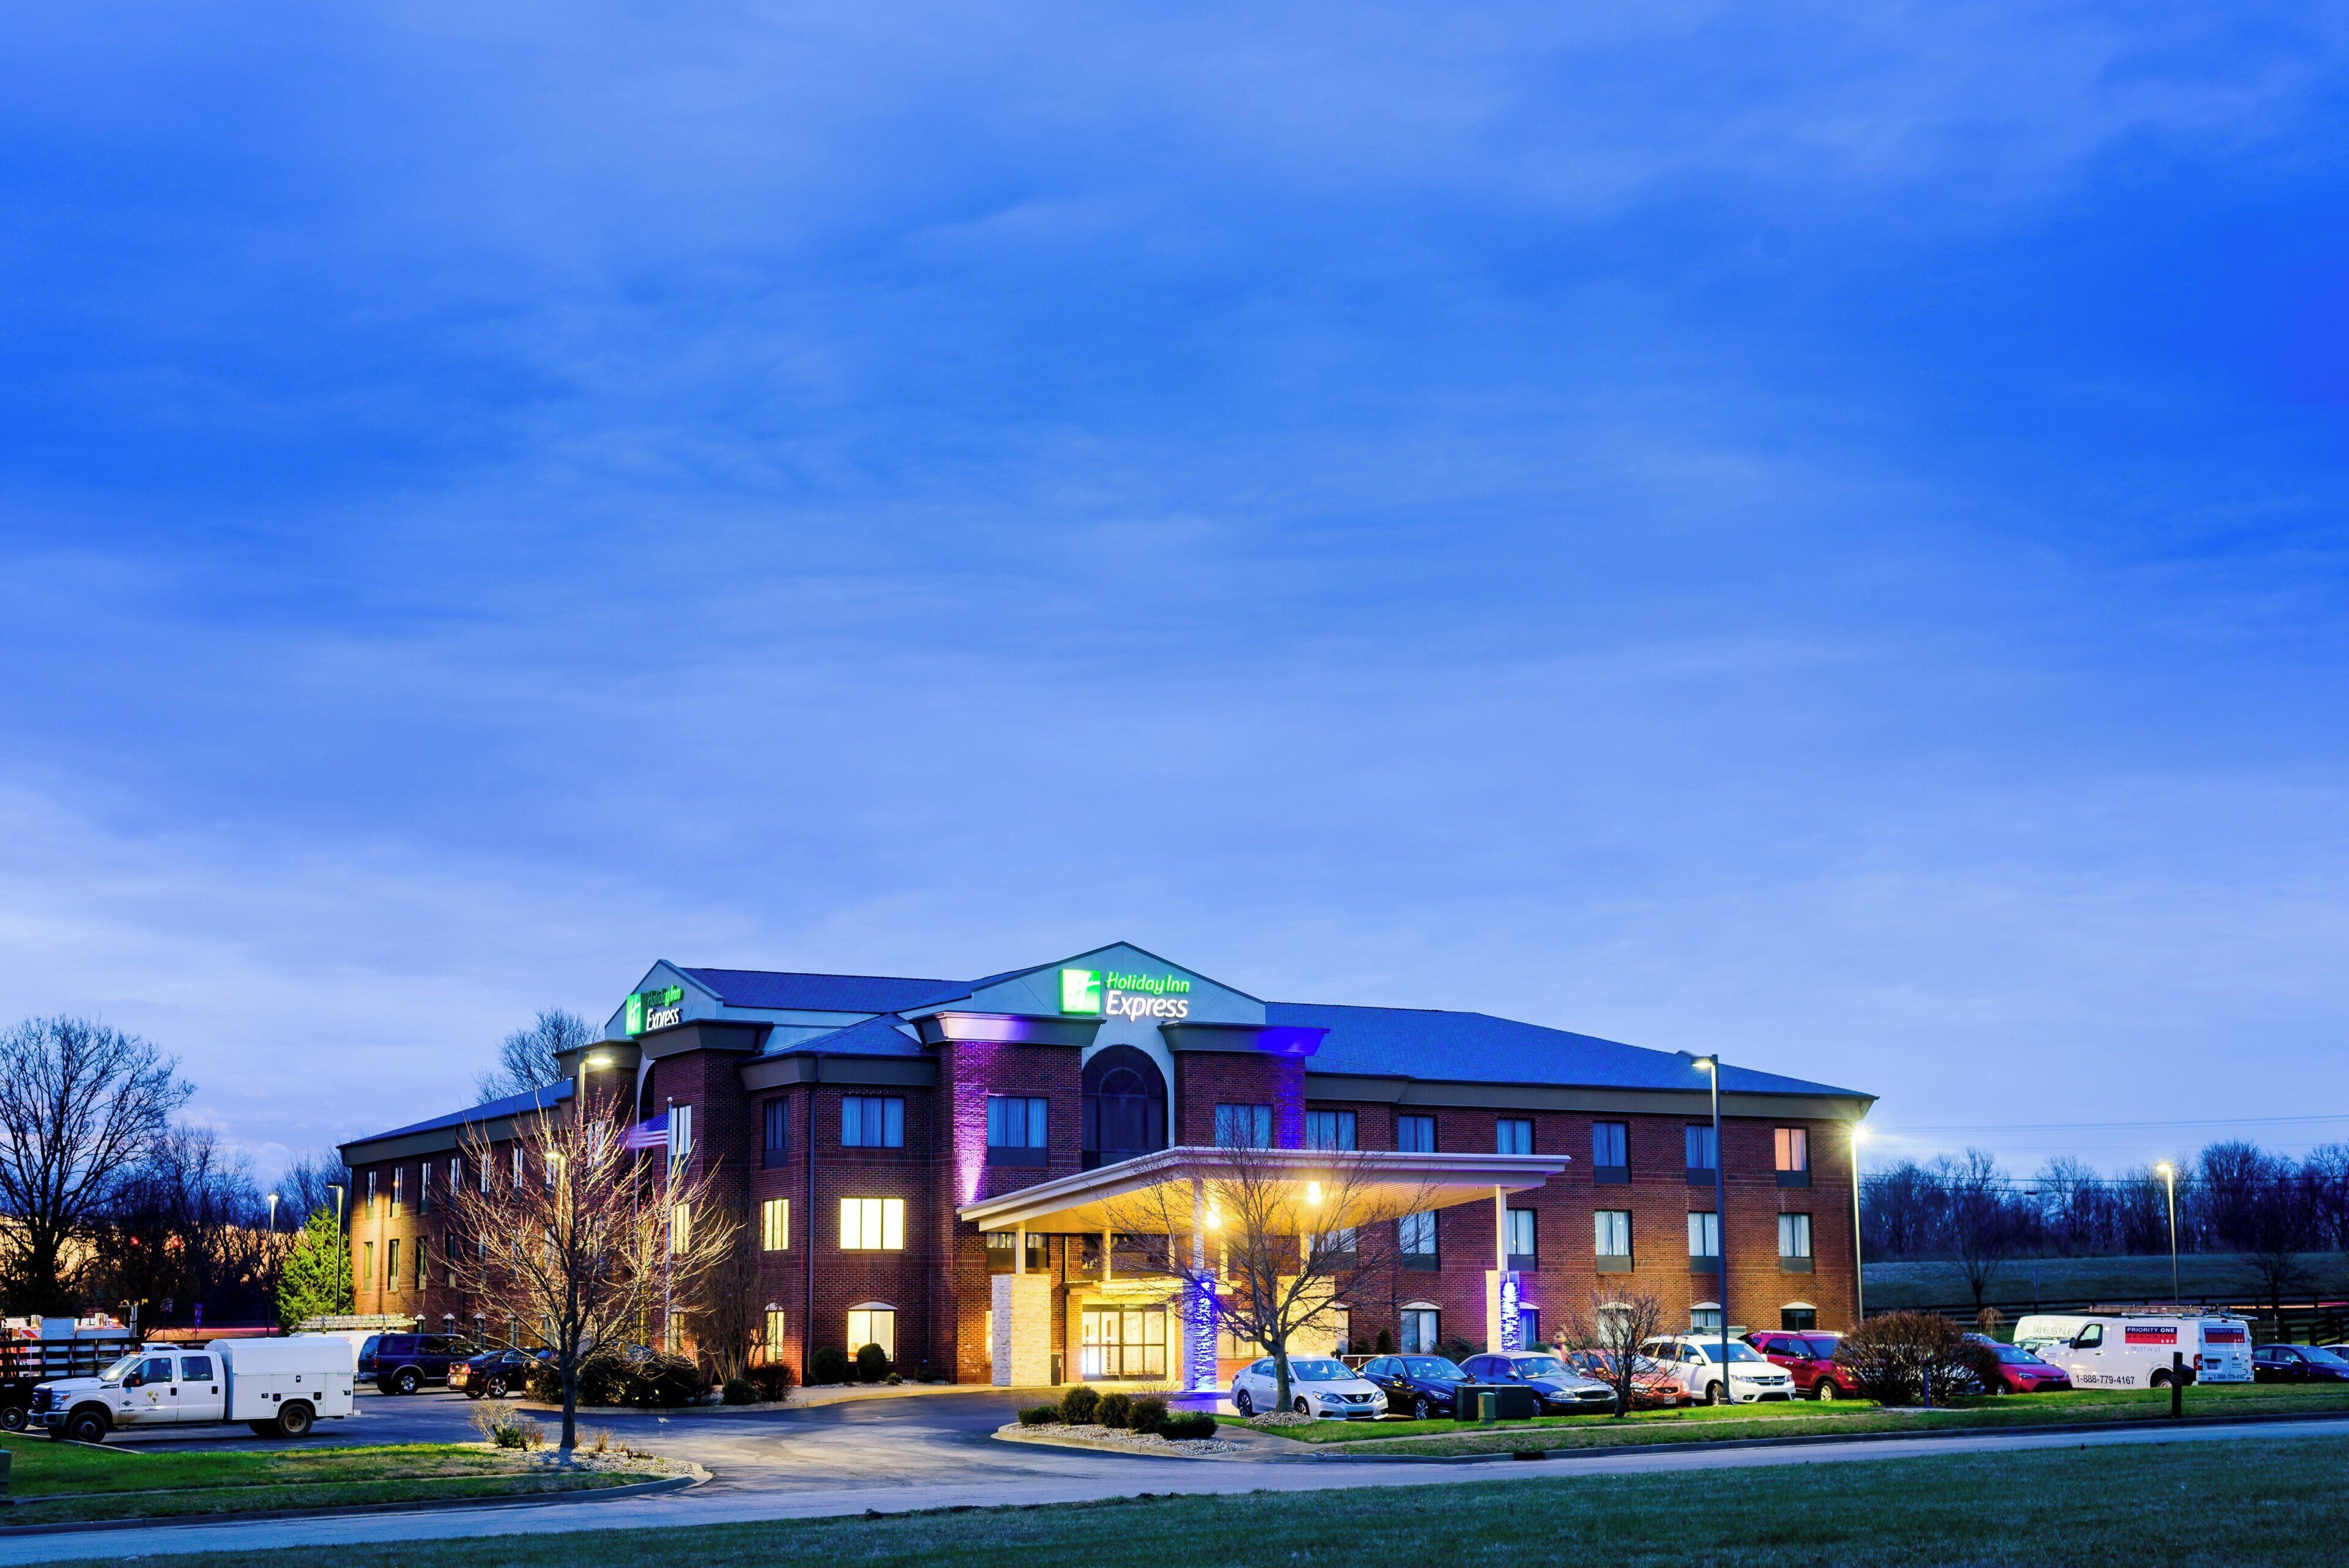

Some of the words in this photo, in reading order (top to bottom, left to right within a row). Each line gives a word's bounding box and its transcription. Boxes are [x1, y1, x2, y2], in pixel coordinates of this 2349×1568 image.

[647, 988, 671, 1006] Holiday
[670, 984, 683, 1001] Inn
[1105, 972, 1164, 995] Holiday
[1167, 975, 1190, 993] Inn
[1105, 990, 1189, 1022] Express
[646, 1008, 679, 1031] Express
[2076, 1374, 2135, 1384] 1-888-779-4167
